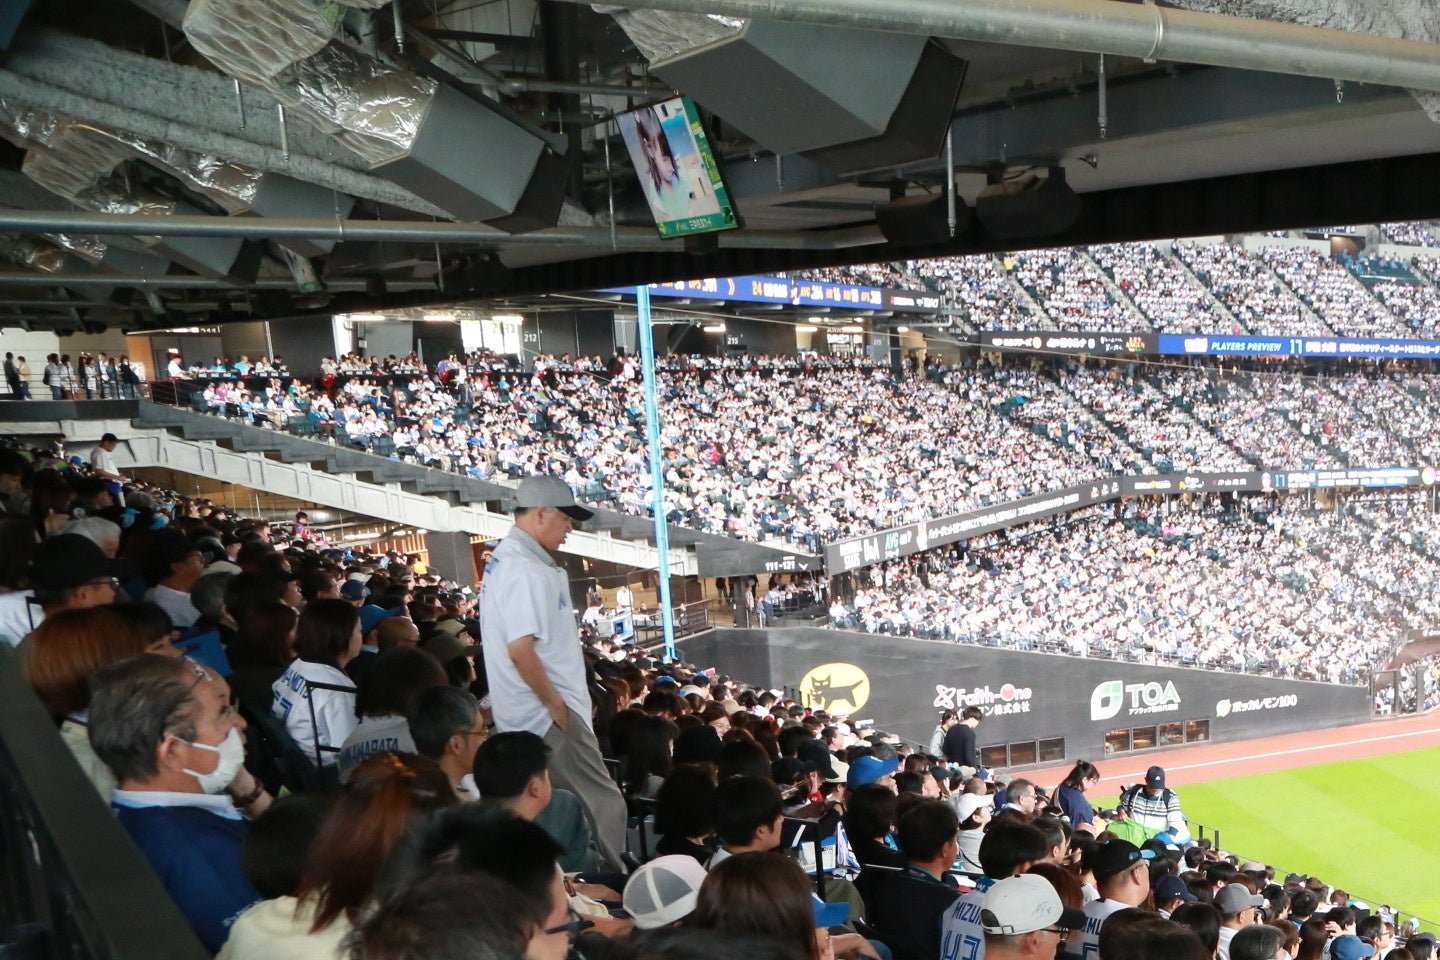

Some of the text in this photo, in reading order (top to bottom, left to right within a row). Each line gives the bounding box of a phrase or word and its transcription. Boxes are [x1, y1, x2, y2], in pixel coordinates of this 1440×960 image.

[524, 333, 537, 342] 212
[727, 337, 739, 345] 215
[1211, 339, 1303, 354] PLAYERS PREVIEW 17
[1275, 474, 1285, 487] 17
[765, 560, 796, 571] 111-121
[1125, 680, 1181, 708] TOA
[1231, 694, 1298, 713] ポッカレモン100
